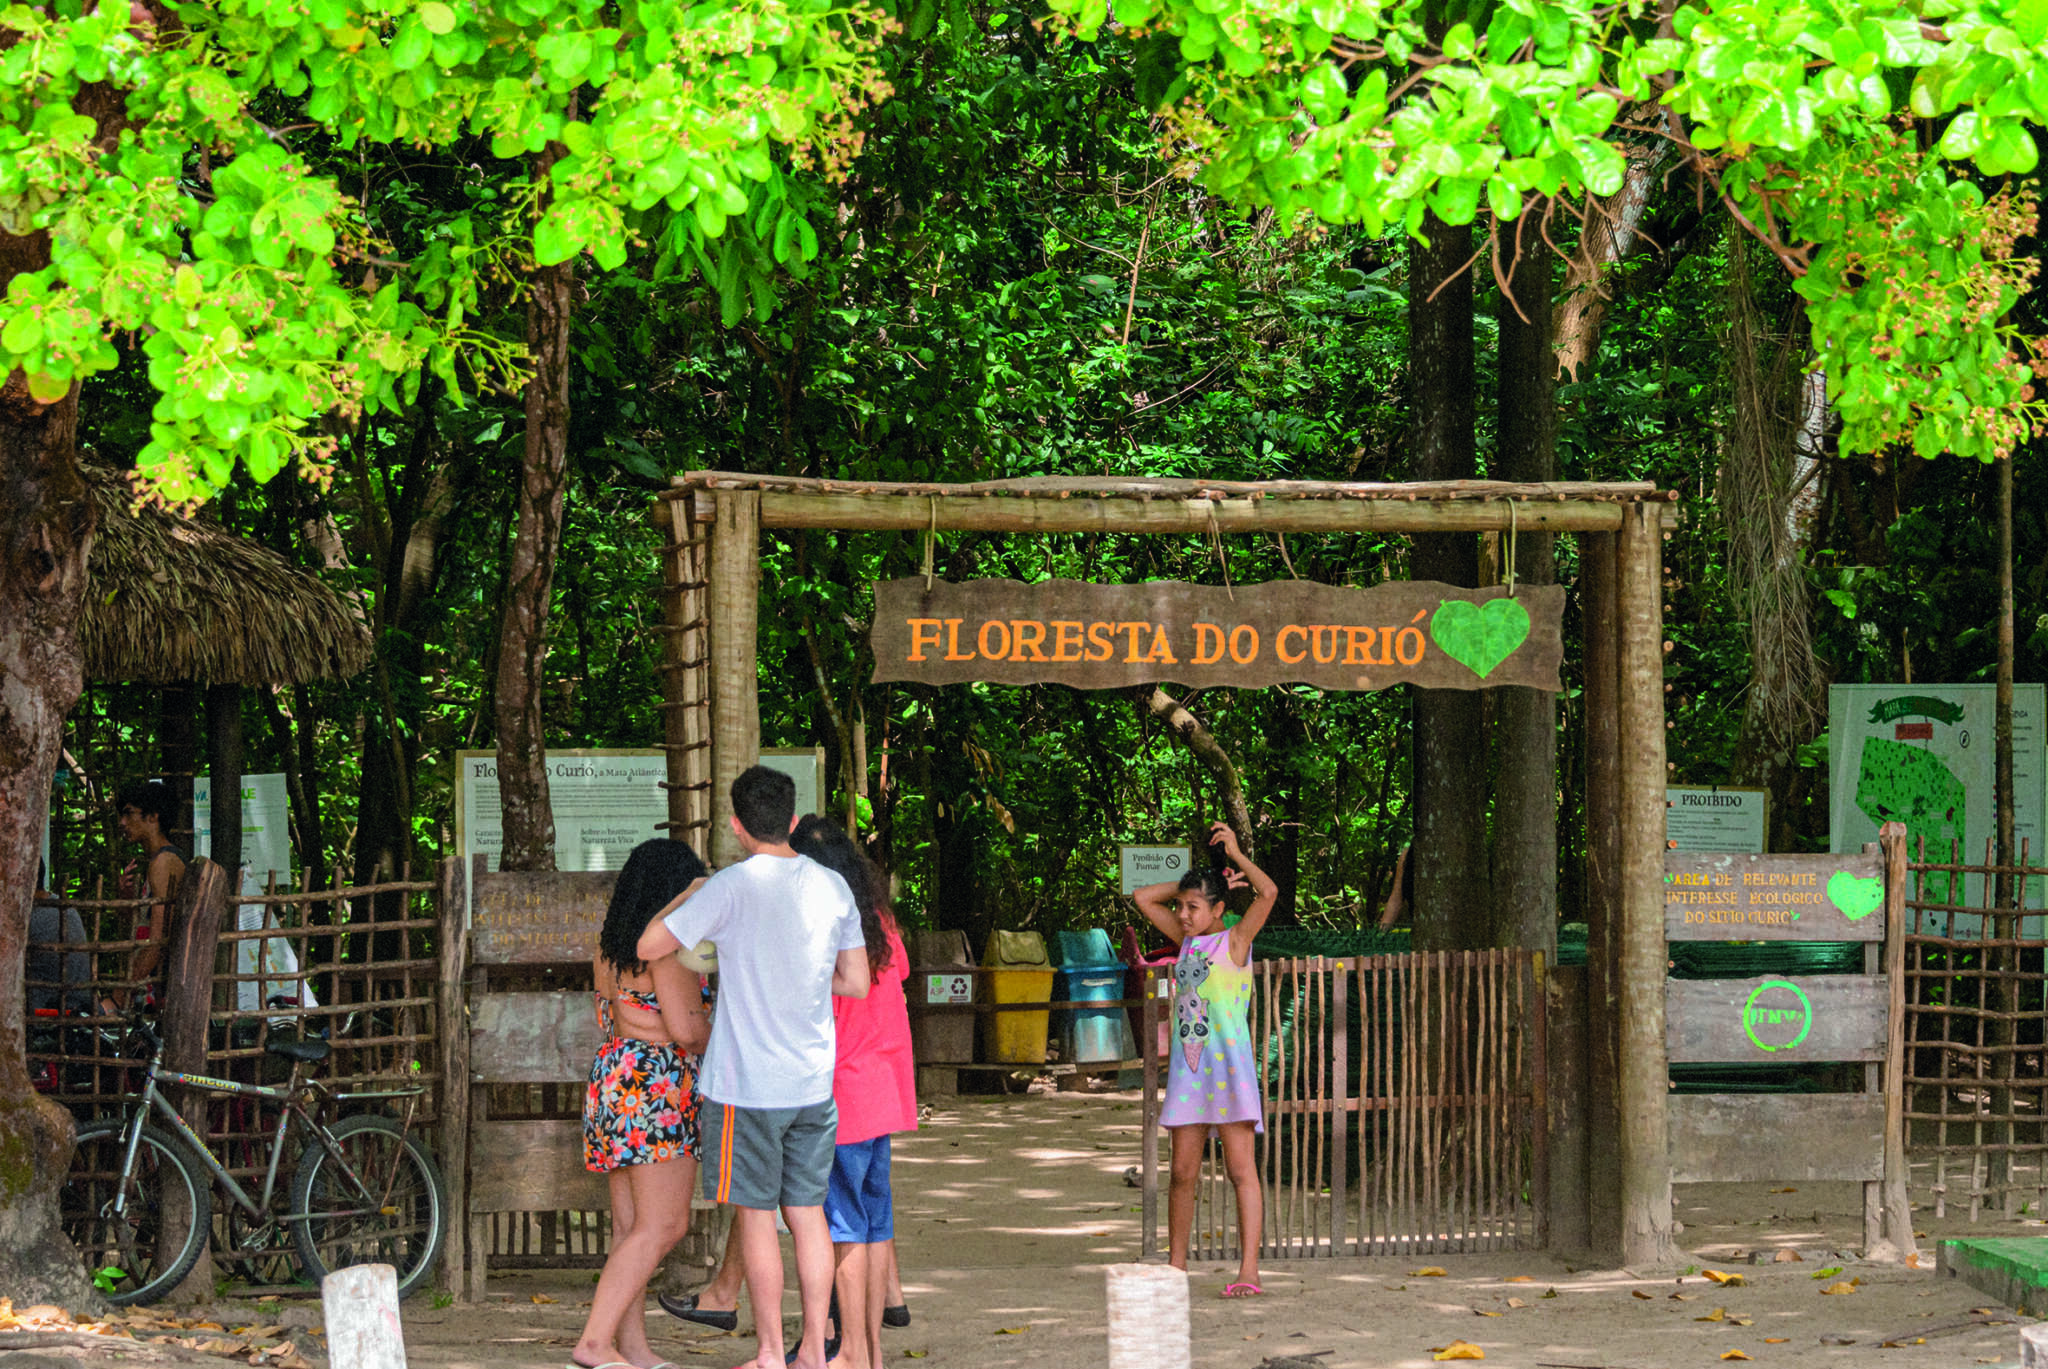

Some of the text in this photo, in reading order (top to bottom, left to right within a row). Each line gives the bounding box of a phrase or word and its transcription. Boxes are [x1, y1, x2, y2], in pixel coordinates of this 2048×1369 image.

[906, 608, 1427, 666] FLORESTA DO CURIÓ
[473, 763, 497, 778] Flo
[1681, 794, 1743, 808] PROIBIDO
[1132, 853, 1164, 862] Proibido
[1136, 863, 1160, 871] Fumar
[1715, 872, 1733, 886] DE
[1743, 872, 1817, 887] RELEVANTE
[1666, 891, 1737, 905] INTERESSE
[1684, 911, 1705, 924] DO
